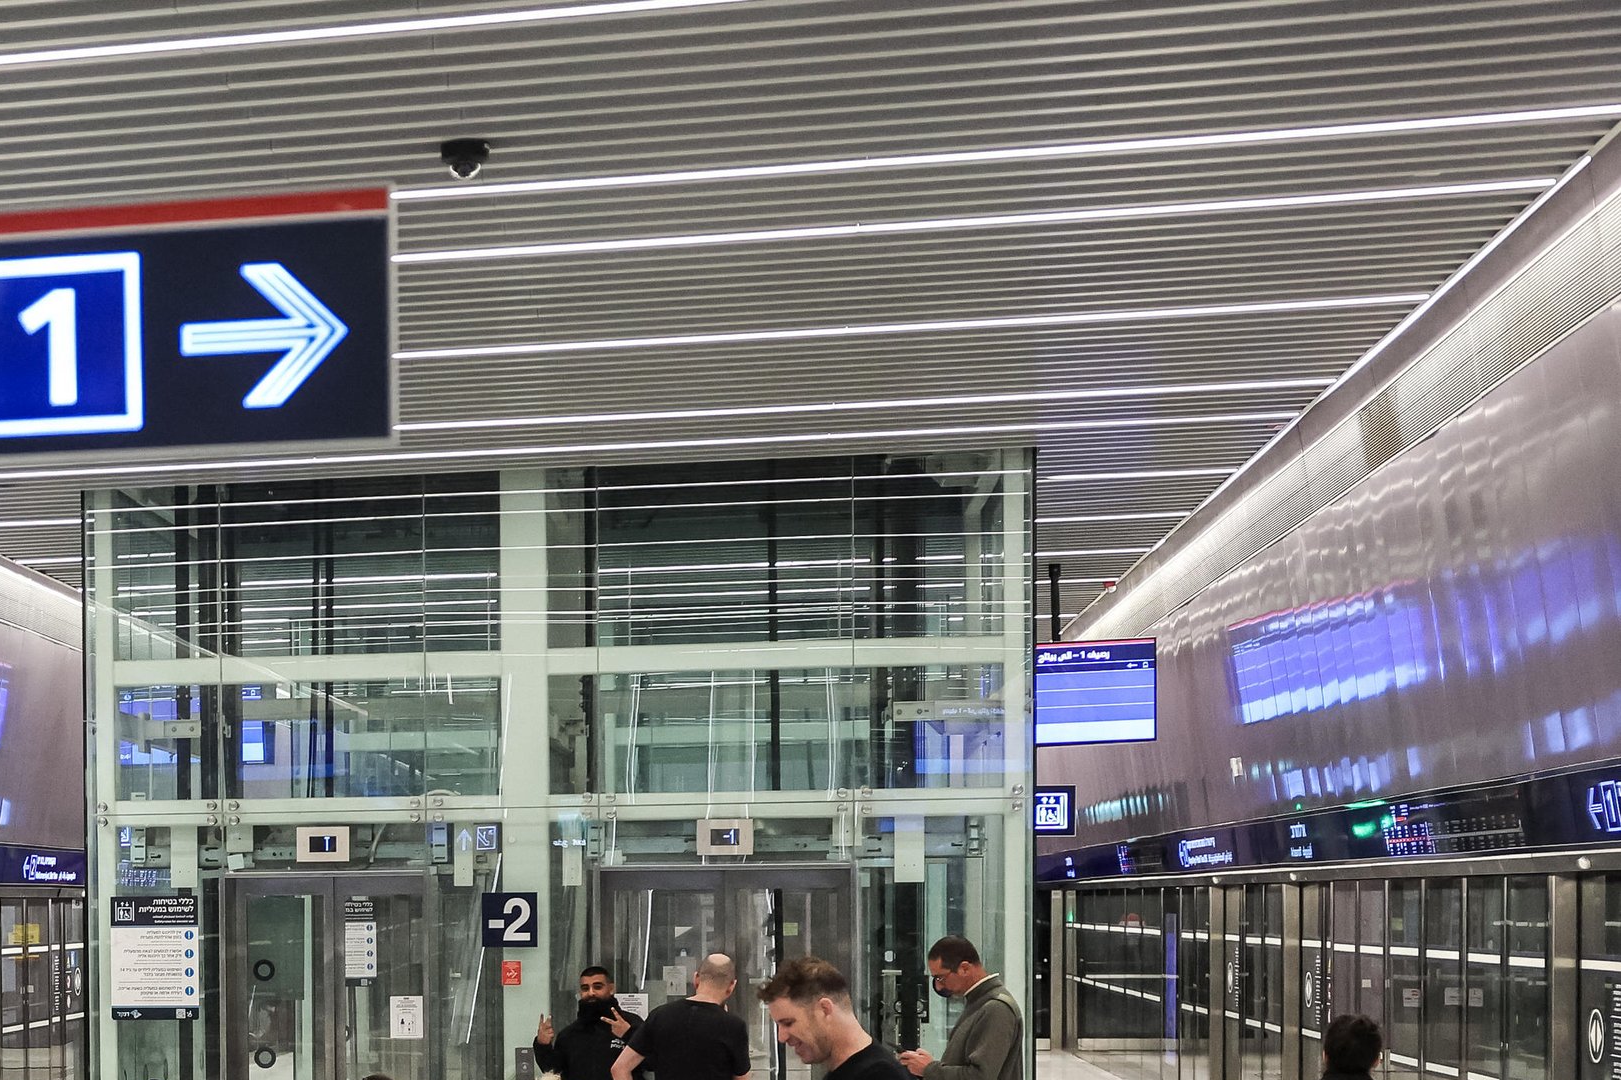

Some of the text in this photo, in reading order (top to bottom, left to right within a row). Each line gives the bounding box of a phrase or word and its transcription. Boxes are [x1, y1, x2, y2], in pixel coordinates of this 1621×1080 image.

[20, 287, 77, 406] 1
[138, 905, 167, 913] במעליות
[178, 897, 194, 905] כללי
[488, 897, 531, 941] -2
